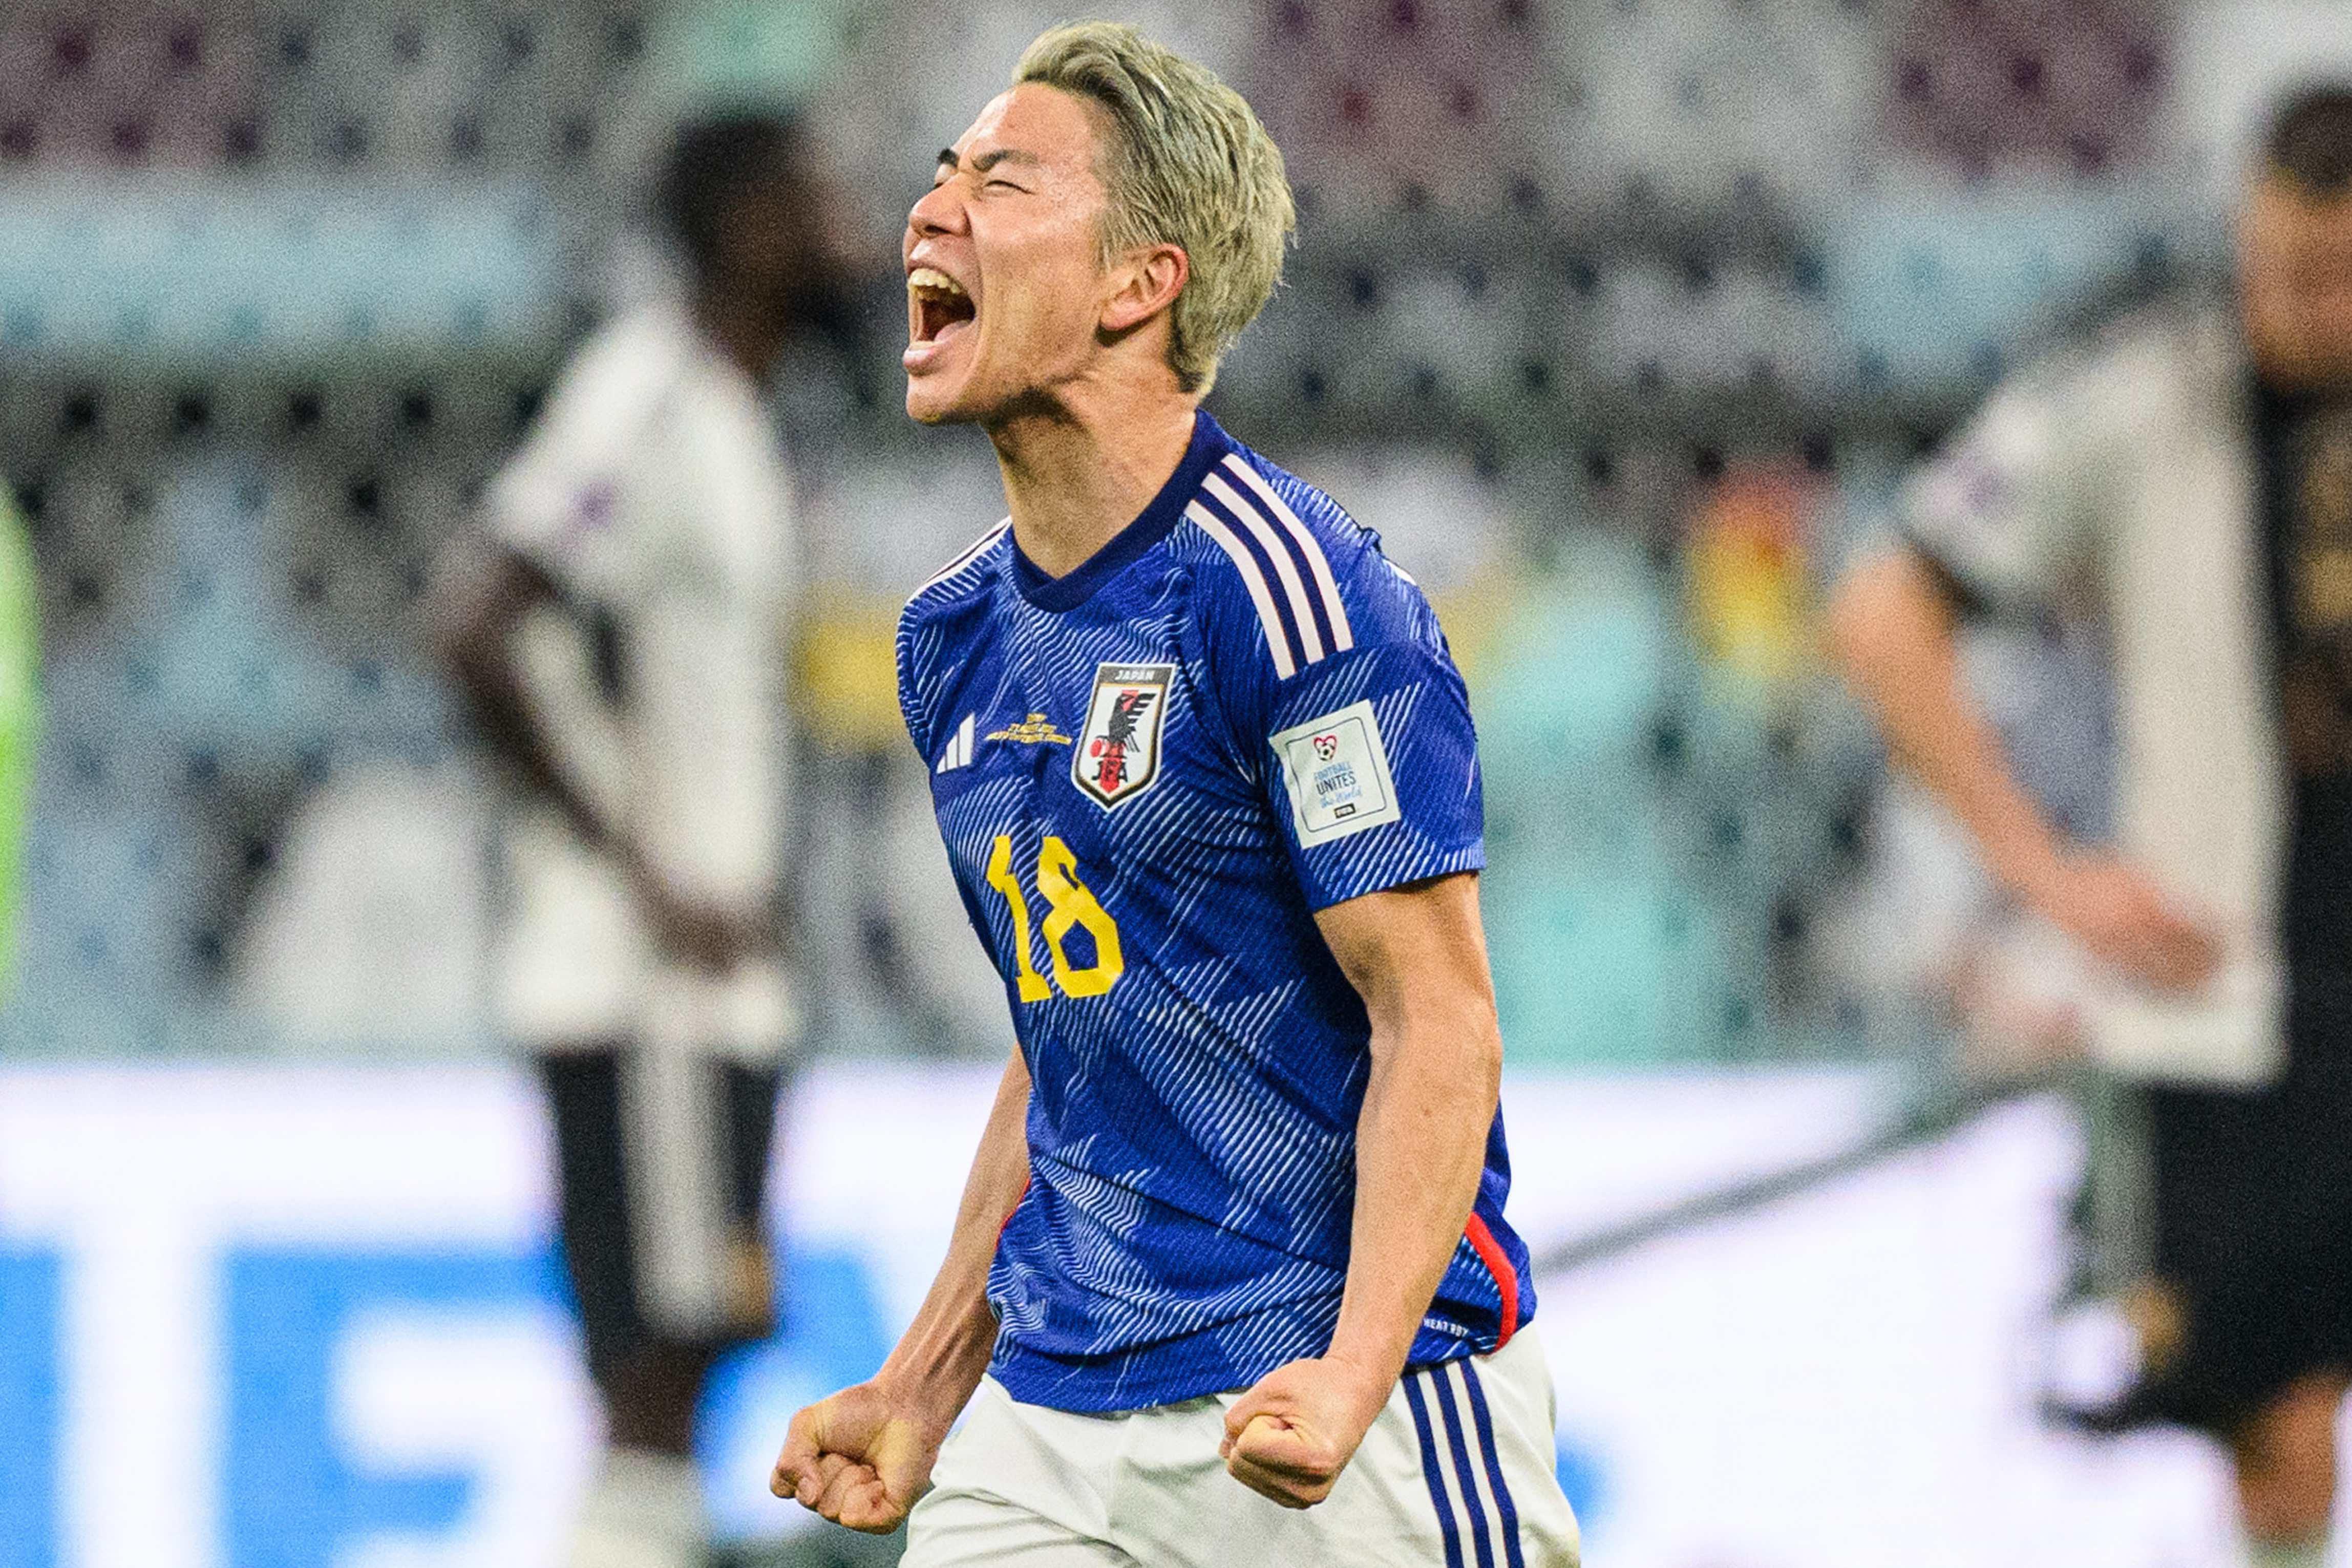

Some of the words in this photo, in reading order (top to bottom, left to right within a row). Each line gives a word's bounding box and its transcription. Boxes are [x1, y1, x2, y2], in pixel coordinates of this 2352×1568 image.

[1114, 670, 1155, 681] JAPAN
[1316, 771, 1357, 795] UNITES
[986, 835, 1125, 1003] 18
